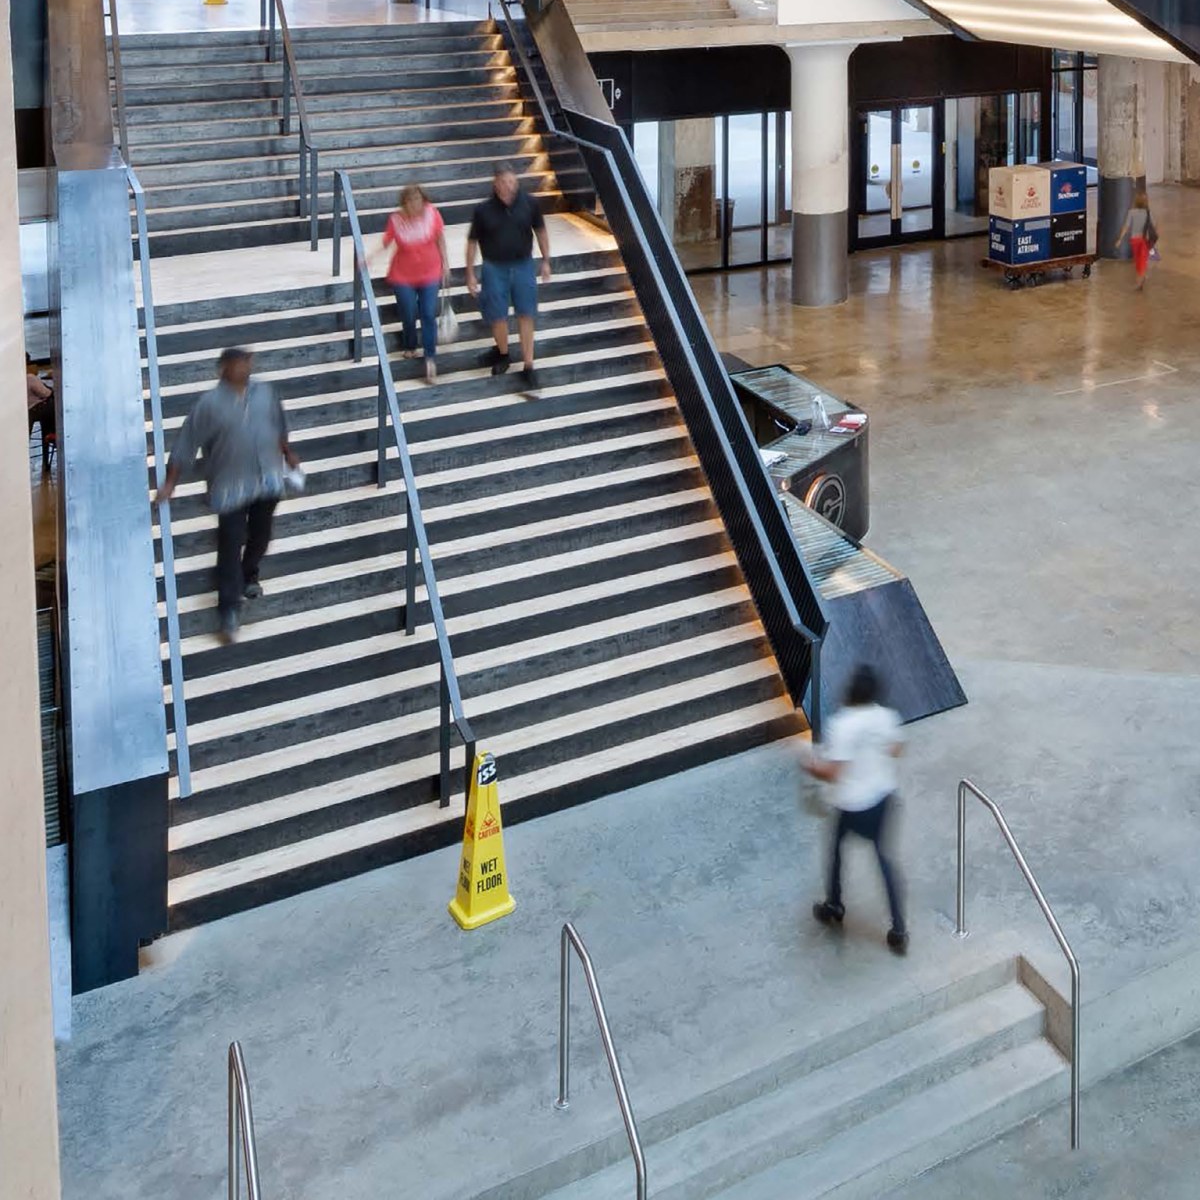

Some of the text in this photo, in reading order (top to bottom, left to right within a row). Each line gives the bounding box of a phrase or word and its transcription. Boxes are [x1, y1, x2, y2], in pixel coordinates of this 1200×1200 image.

[1017, 235, 1032, 246] EAST
[1017, 243, 1040, 255] ATRIUM
[478, 826, 501, 840] CAUTION
[480, 856, 499, 876] WET
[476, 872, 503, 895] FLOOR
